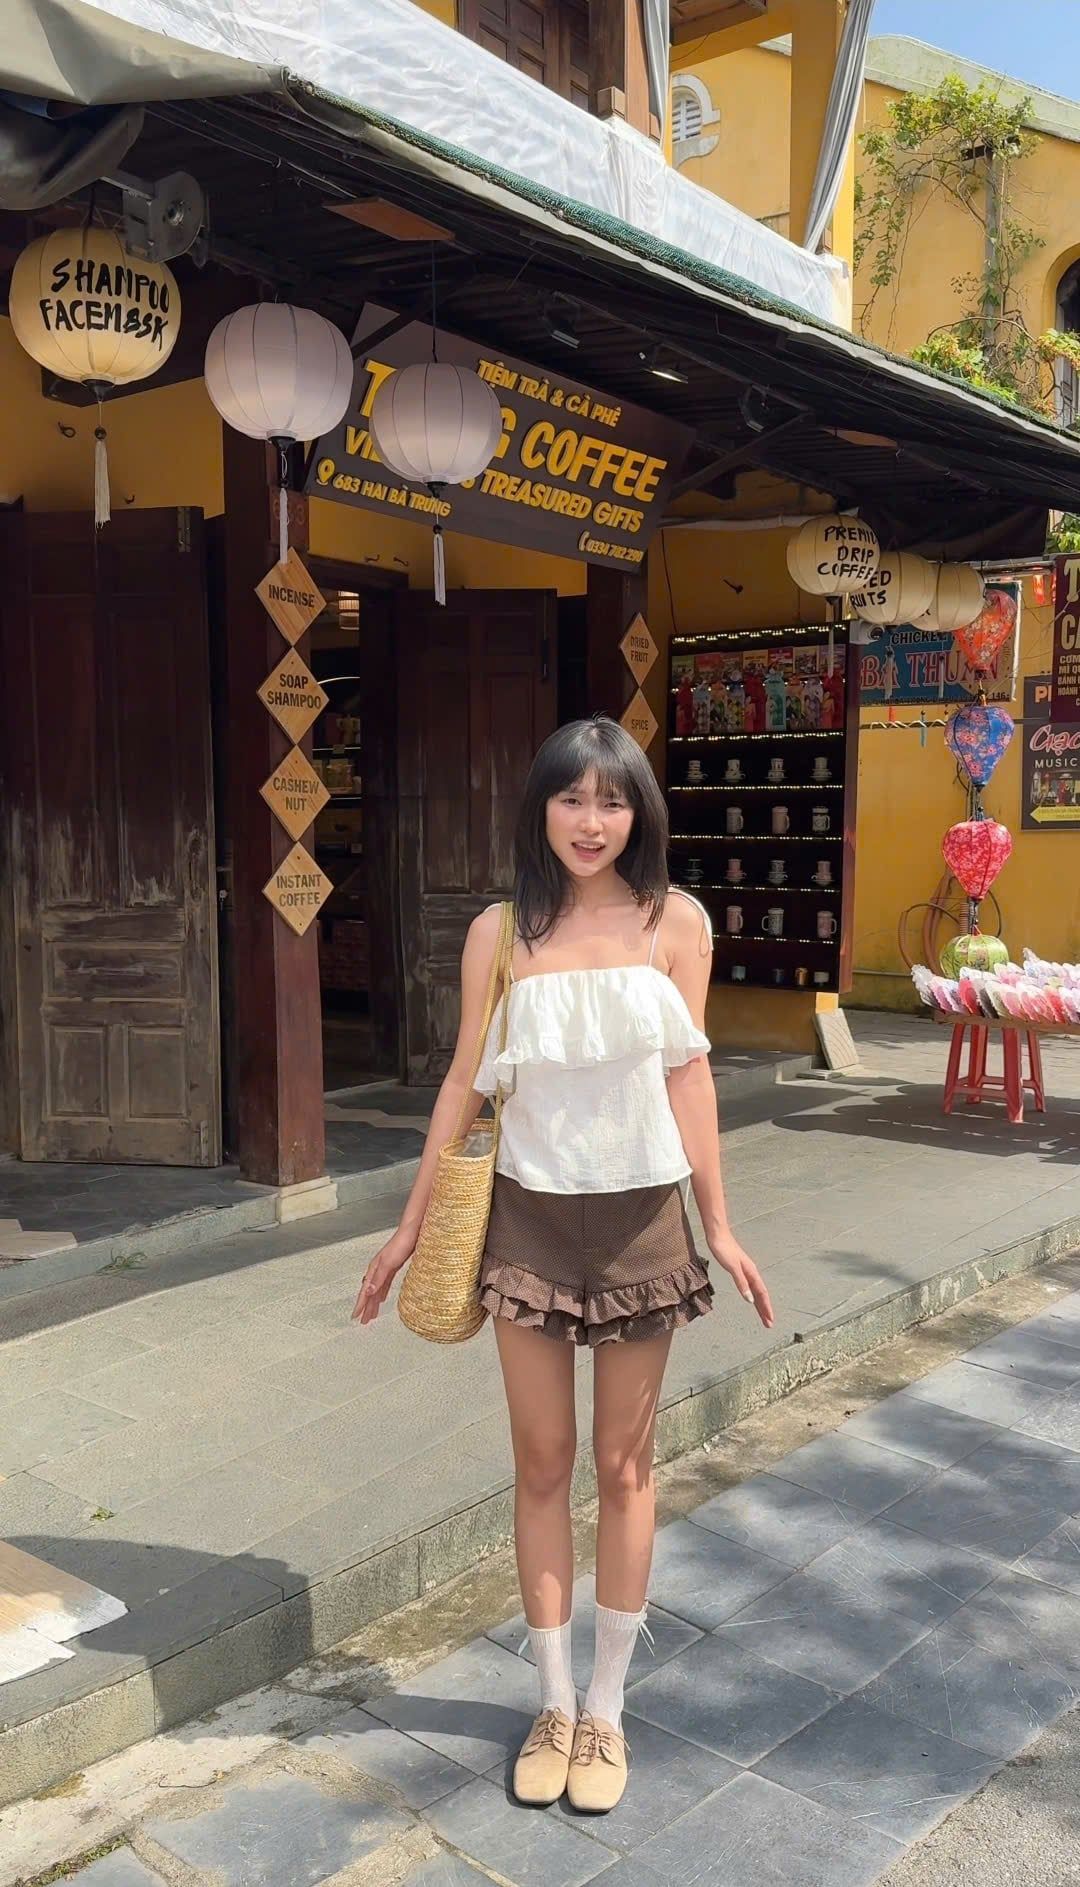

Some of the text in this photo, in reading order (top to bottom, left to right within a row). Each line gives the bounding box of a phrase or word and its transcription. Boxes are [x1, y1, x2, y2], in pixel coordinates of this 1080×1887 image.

[519, 375, 550, 402] TRÀ
[551, 389, 564, 407] &
[565, 394, 590, 417] CÀ
[591, 406, 622, 428] PHÊ
[520, 420, 667, 502] COFFEE
[333, 474, 361, 494] 683
[361, 480, 388, 502] HAI
[388, 484, 409, 507] BÀ
[480, 469, 645, 533] TREASURED GIFTS
[837, 545, 874, 564] DRIP
[268, 584, 316, 609] INCENSE
[630, 635, 649, 649] DRIED
[630, 650, 649, 664] FRUIT
[279, 673, 309, 690] SOAP
[267, 690, 322, 710] SHAMPOO
[631, 717, 649, 731] SPICE
[1034, 757, 1078, 769] MUSIC
[272, 775, 320, 796] CASHEW
[285, 796, 308, 813] NUT
[276, 873, 322, 890] INSTANT
[278, 891, 321, 908] COFFEE
